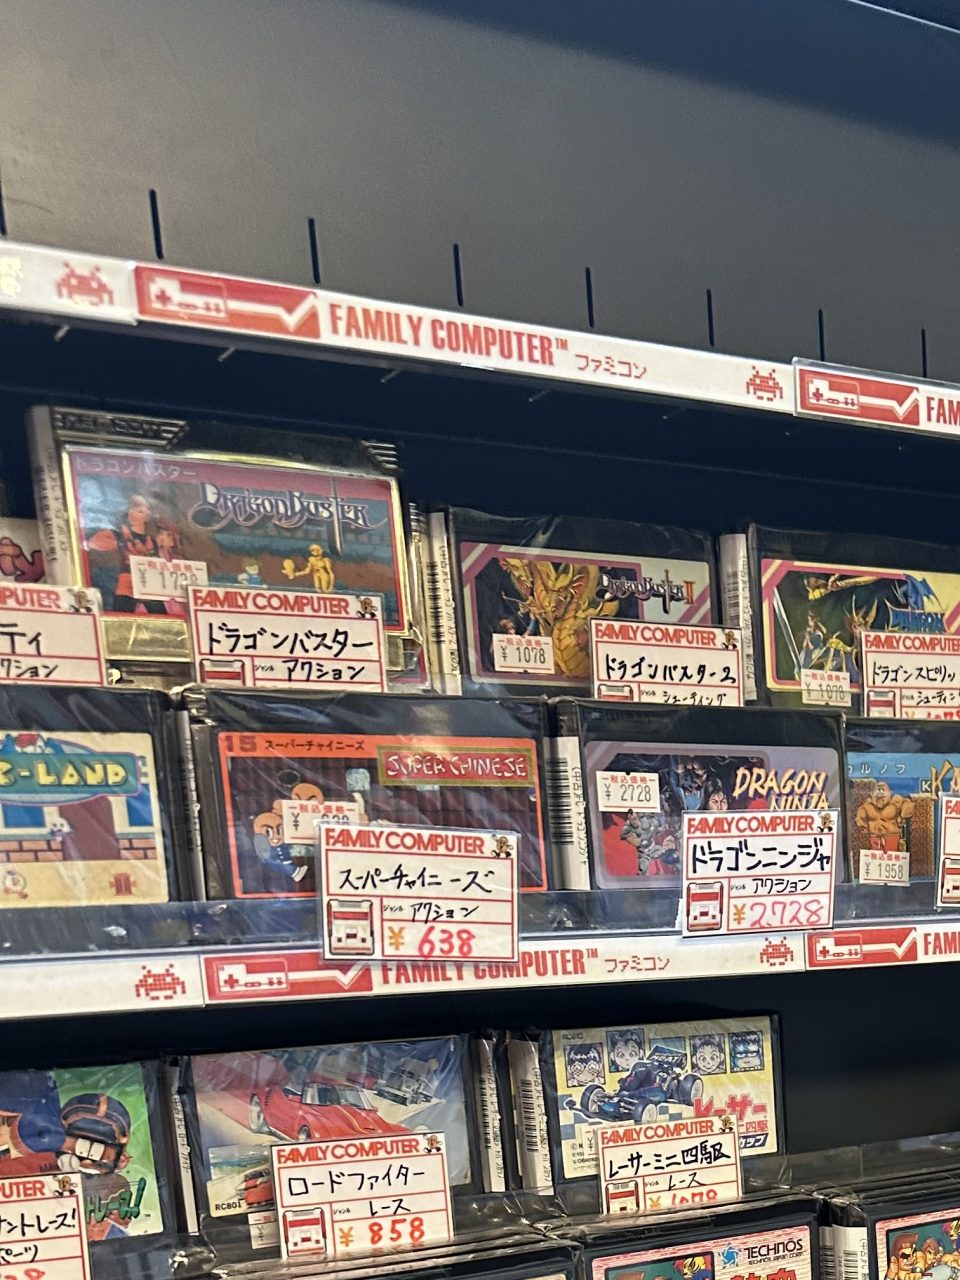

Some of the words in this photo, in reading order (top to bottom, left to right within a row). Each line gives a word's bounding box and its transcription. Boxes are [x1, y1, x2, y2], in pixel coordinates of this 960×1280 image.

[330, 302, 420, 346] FAMILY
[577, 353, 647, 379] ファミコン
[193, 588, 251, 611] FAMILY
[252, 591, 349, 615] COMPUTER
[209, 622, 374, 656] ドラゴンバスター
[595, 623, 641, 640] FAMILY
[642, 627, 717, 646] COMPUTER
[864, 634, 902, 650] FAMILY
[515, 646, 546, 665] 1078
[285, 659, 365, 682] アクション
[265, 739, 365, 751] スーパーチャイニーズ
[450, 757, 528, 778] CHINESE
[620, 784, 652, 802] 2728
[733, 767, 827, 800] DRAGON
[688, 816, 734, 834] FAMILY
[735, 815, 814, 832] COMPUTER
[325, 828, 382, 850] FAMILY
[382, 831, 485, 855] COMPUTER
[692, 837, 831, 874] ドラゴンニンジャ
[339, 863, 495, 893] スーパーチャイニーズ
[877, 863, 905, 880] 1958
[752, 878, 812, 894] アクション
[411, 902, 479, 924] アクション
[418, 925, 476, 958] 638
[601, 1127, 641, 1144] FAMILY
[642, 1120, 714, 1141] COMPUTER
[277, 1148, 328, 1164] FAMILY
[332, 1139, 419, 1159] COMPUTER
[609, 1141, 731, 1178] レーサーミニ四駆
[289, 1163, 425, 1196] ロードファイター
[668, 1172, 706, 1190] レース
[369, 1199, 411, 1217] レース
[368, 1217, 425, 1245] 858
